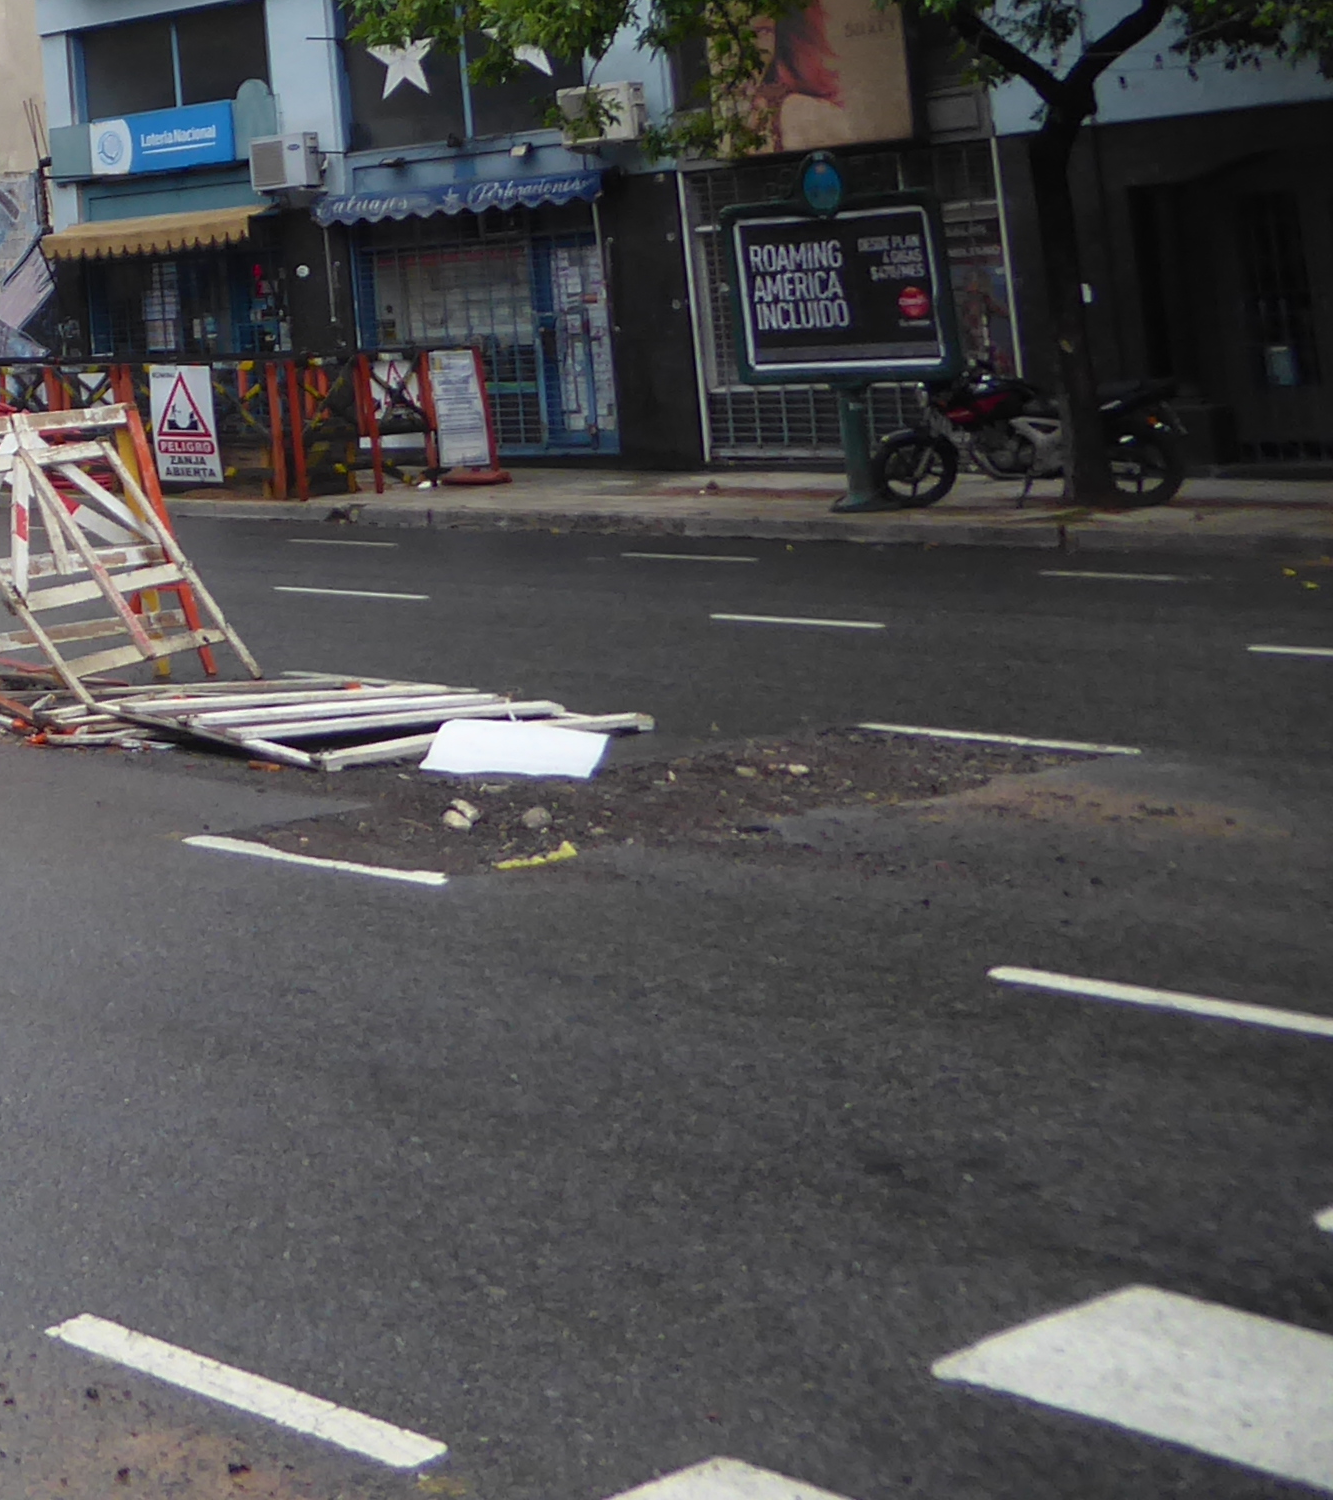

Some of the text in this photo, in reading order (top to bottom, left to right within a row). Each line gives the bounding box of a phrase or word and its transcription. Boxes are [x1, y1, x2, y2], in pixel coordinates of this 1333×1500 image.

[173, 125, 216, 142] Nacional
[891, 234, 920, 249] PLAN
[749, 240, 842, 272] ROAMING
[756, 300, 850, 330] INCLUIDO
[160, 441, 212, 453] PELIGRO
[169, 455, 207, 466] ZANJA
[165, 466, 217, 478] ABIERTA
